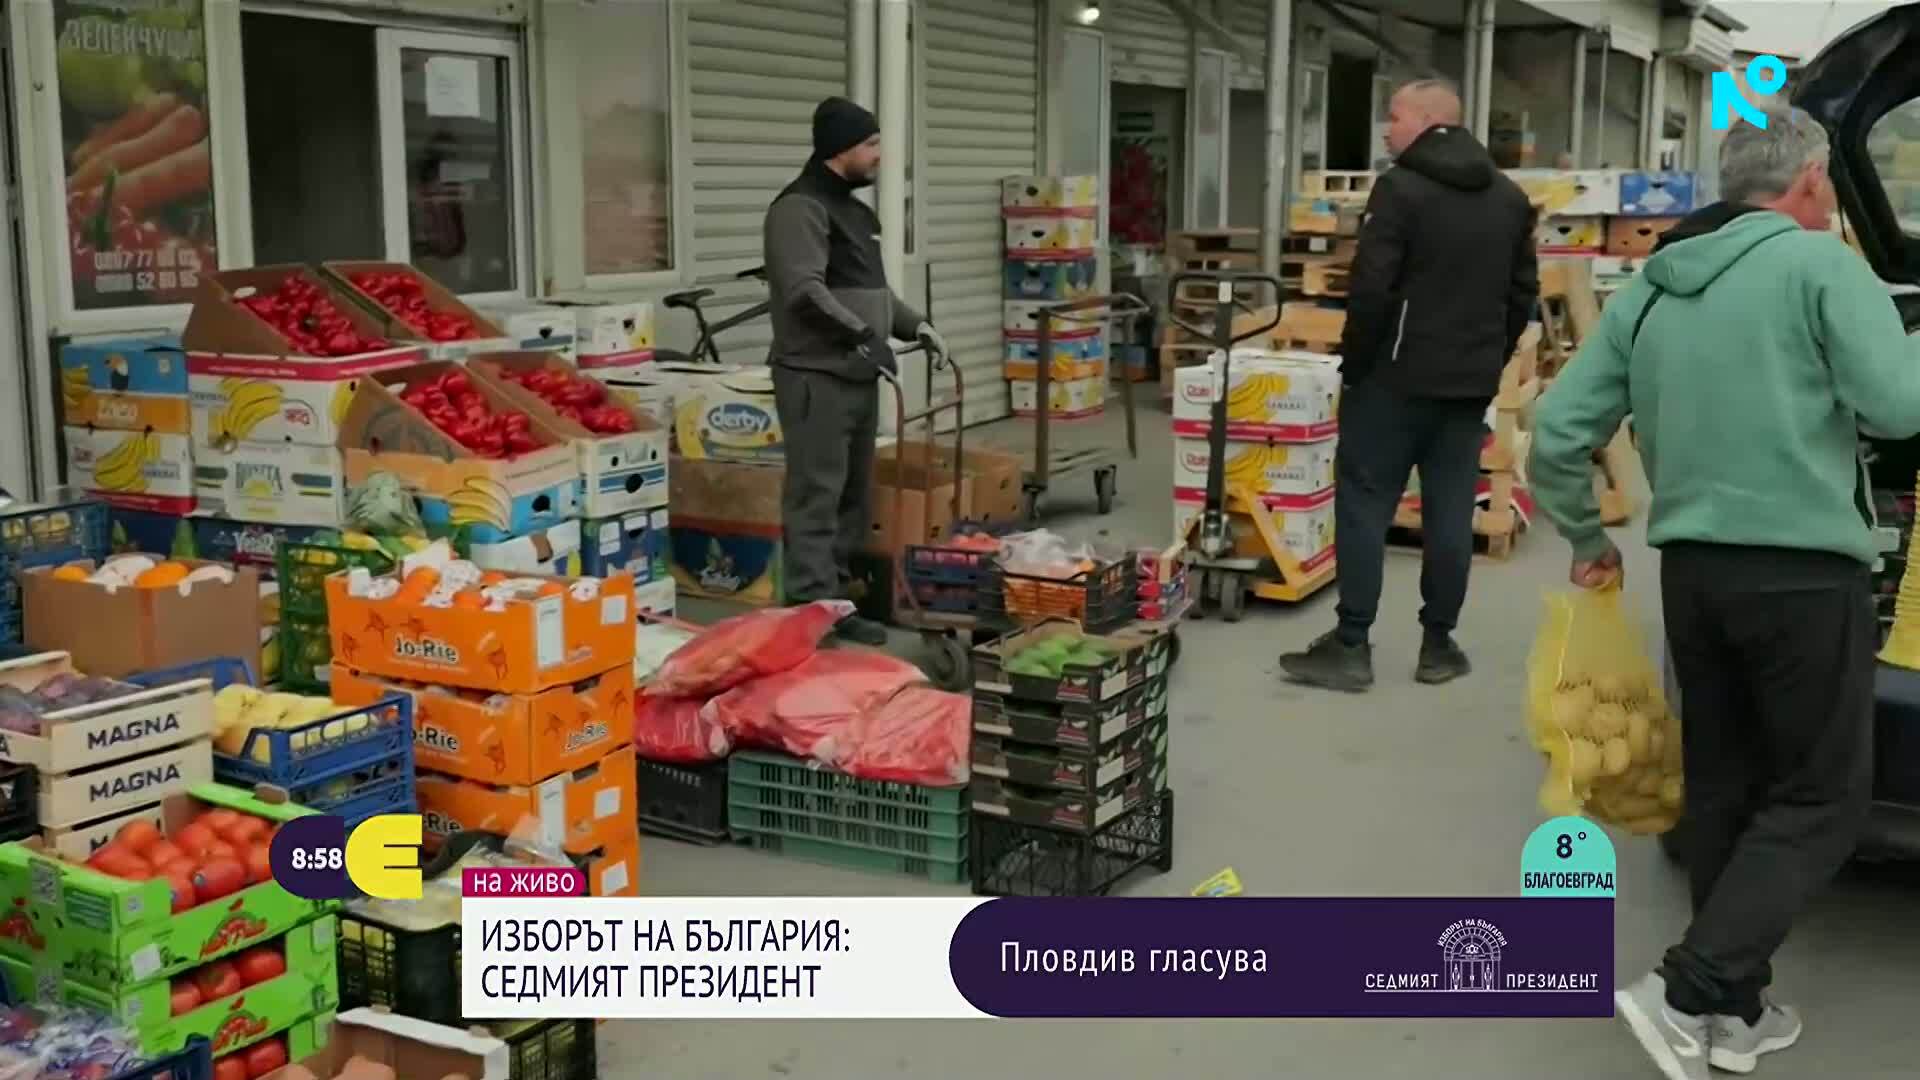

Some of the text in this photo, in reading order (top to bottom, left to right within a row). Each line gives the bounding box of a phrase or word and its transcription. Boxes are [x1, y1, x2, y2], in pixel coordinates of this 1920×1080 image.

[711, 404, 768, 432] derby
[87, 712, 180, 750] MAGNA
[89, 763, 181, 803] MAGNA
